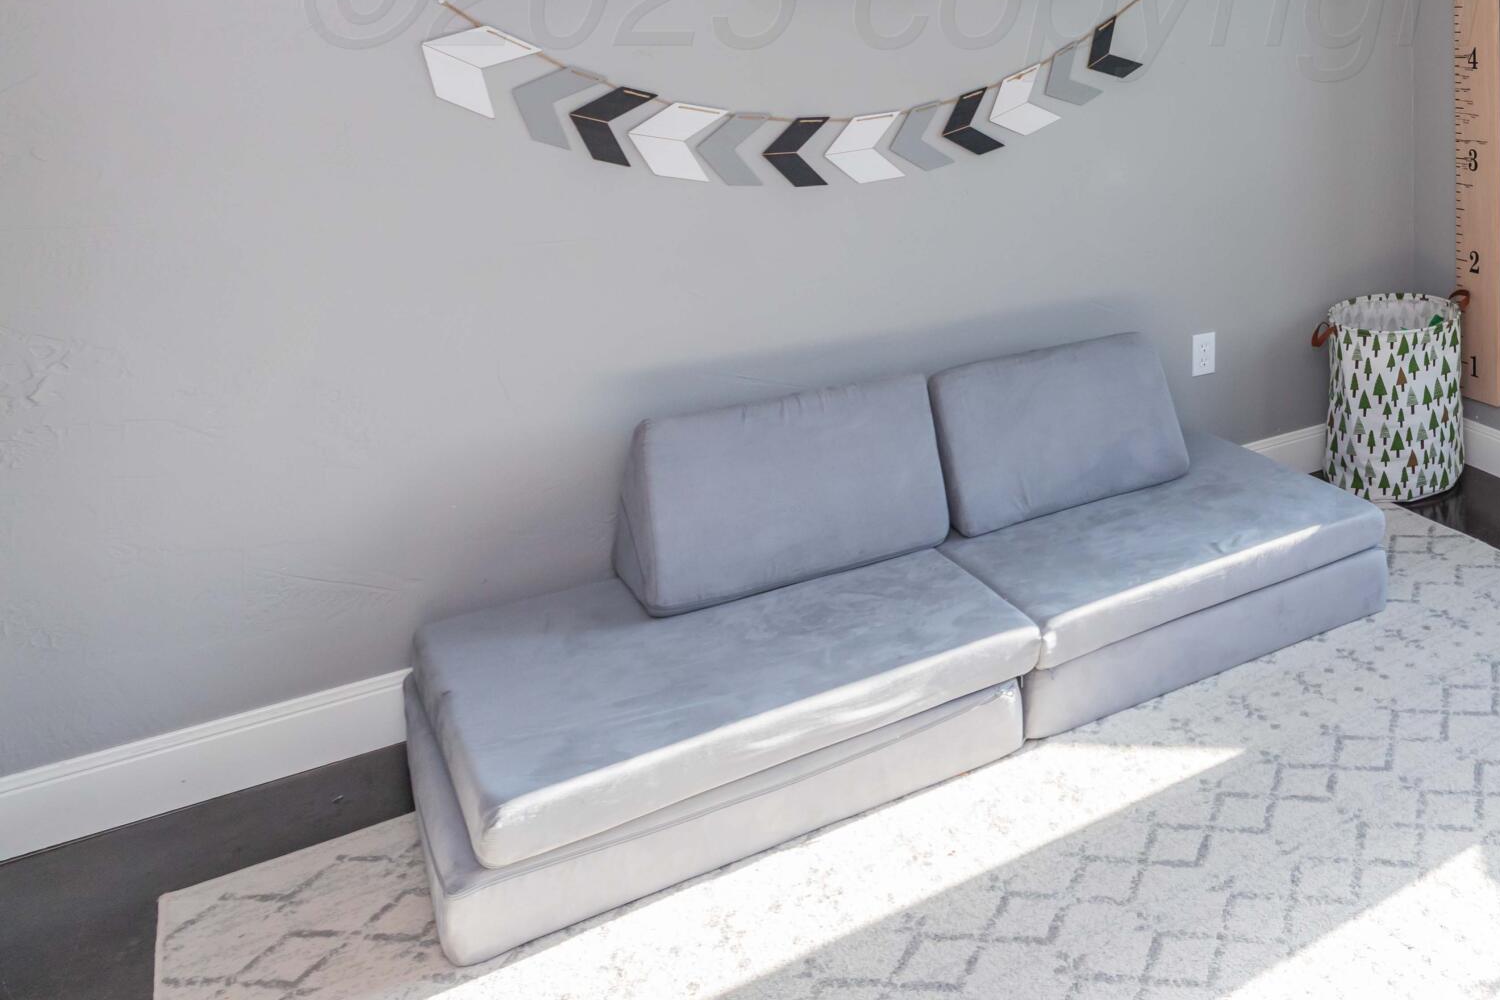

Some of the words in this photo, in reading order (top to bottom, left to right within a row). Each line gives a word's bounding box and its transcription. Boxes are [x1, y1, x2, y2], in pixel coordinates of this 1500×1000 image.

[1467, 47, 1479, 70] 4
[1468, 148, 1479, 172] 3
[1468, 250, 1480, 275] 2
[1469, 355, 1479, 378] 1
